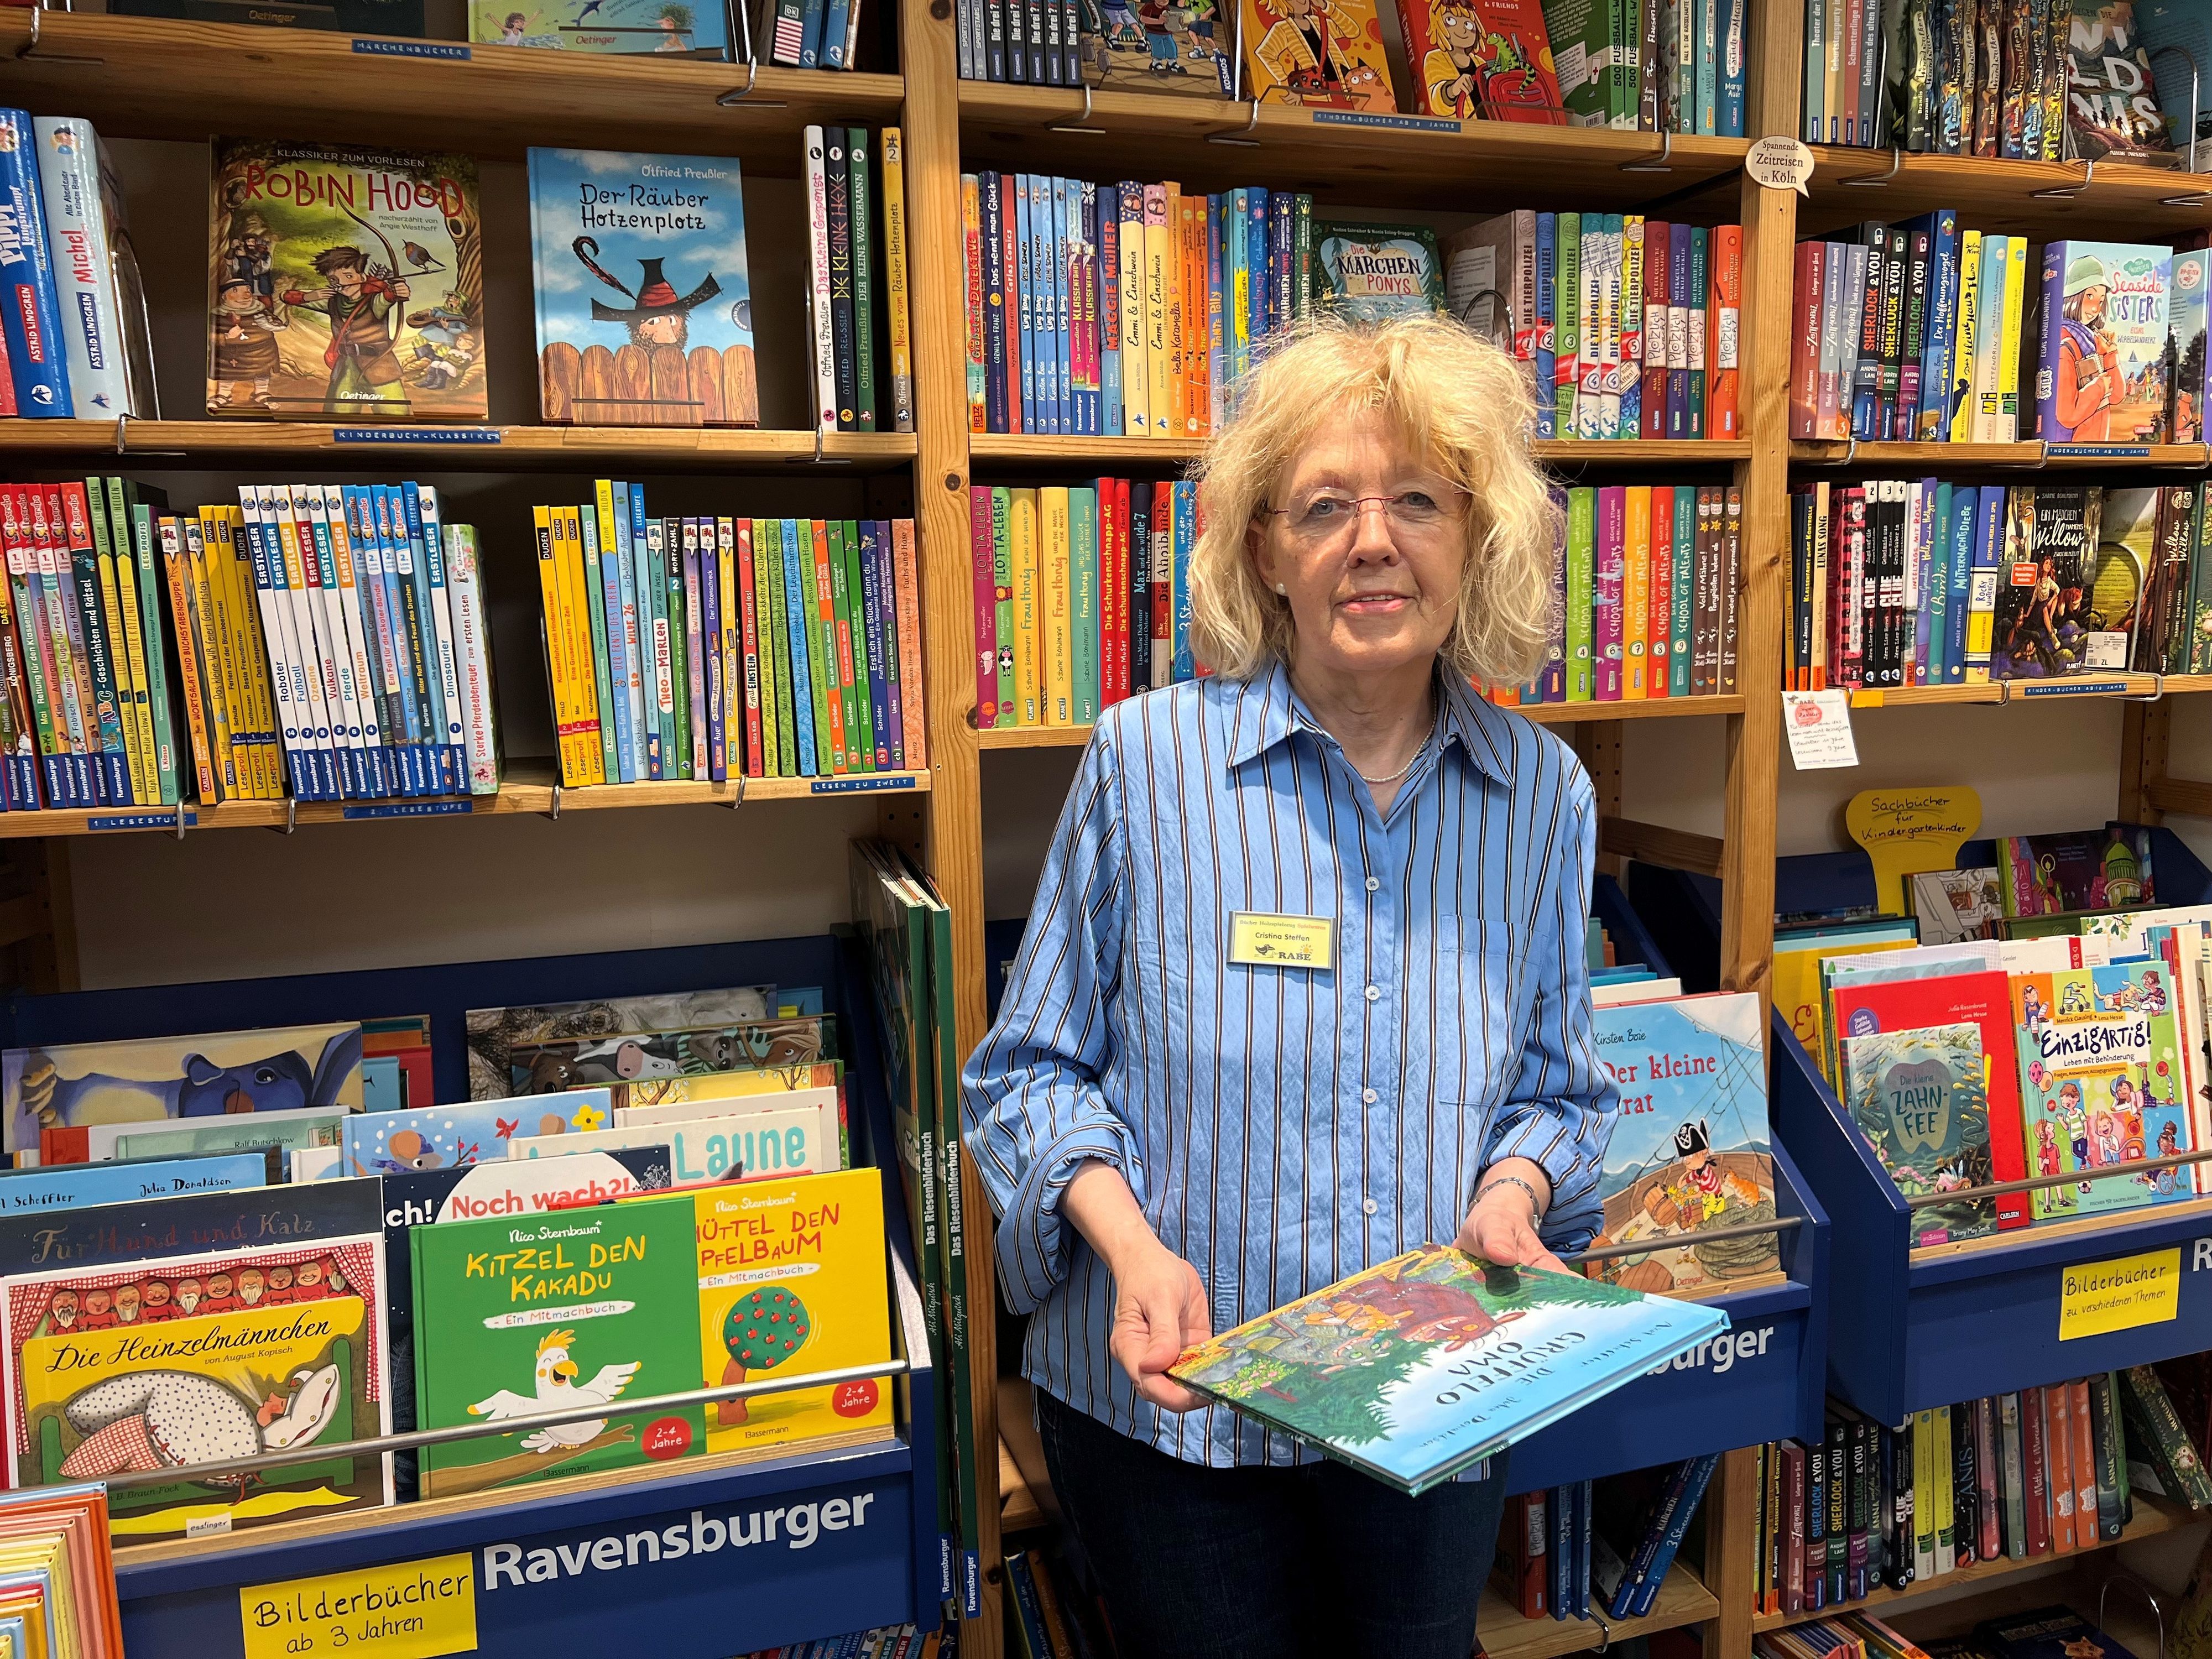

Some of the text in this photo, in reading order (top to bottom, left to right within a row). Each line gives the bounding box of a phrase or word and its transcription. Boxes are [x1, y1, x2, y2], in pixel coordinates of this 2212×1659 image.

[249, 10, 295, 23] Oetinger
[1223, 57, 1232, 91] KOSMOS
[277, 149, 425, 168] KLASSIKER ZUM VORLESEN
[1763, 140, 1799, 151] Spannende
[641, 164, 728, 180] Otfried Preußler
[1756, 153, 1803, 168] Zeitreisen
[1761, 170, 1797, 184] in Köln
[246, 166, 463, 218] ROBIN HOOD
[580, 182, 708, 207] Der Räuber
[988, 182, 998, 211] Glück
[379, 215, 422, 223] nacherzählt
[582, 205, 706, 234] Hotzenplotz
[855, 173, 865, 243] WASSERMANN
[379, 222, 438, 232] Angie Westhoff
[890, 203, 902, 255] Hotzenplotz
[60, 230, 97, 284] Michel
[858, 245, 867, 277] KLEINE
[989, 235, 999, 265] nennt
[1350, 244, 1365, 254] Die
[891, 258, 903, 292] Räuber
[991, 268, 999, 285] Das
[1336, 255, 1422, 275] MÄRCHEN
[859, 281, 867, 301] DER
[1367, 274, 1411, 295] PONYS
[1524, 245, 1532, 325] DIE TIERPOLIZEI
[2111, 270, 2164, 294] Seaside
[1125, 251, 1139, 347] Emmi & Einschwein
[1864, 252, 1881, 351] SHERLOCK & YOU
[894, 319, 906, 347] Neues
[2027, 508, 2085, 551] Willow
[2041, 509, 2077, 521] EIN MÄDCHEN
[993, 496, 1004, 575] LOTTA-LEBEN
[1817, 515, 1828, 568] LUNAS SONG
[249, 527, 268, 585] ERSTLESER
[1103, 504, 1113, 613] Schurkenschnapp-AG
[1157, 501, 1169, 603] Die Ahoibande
[864, 564, 871, 575] du
[1698, 551, 1708, 609] Volle Mähne!
[1678, 543, 1691, 633] SCHOOL OF TALENTS
[461, 594, 471, 613] Lesen
[867, 599, 875, 625] Stück,
[464, 614, 473, 644] ersten
[276, 661, 290, 702] Roboter
[324, 659, 337, 700] Vulkane
[356, 651, 370, 700] Weltraum
[440, 639, 456, 698] Dinosaurier
[747, 655, 757, 689] EINSTEIN
[291, 665, 306, 703] Fußball
[307, 665, 320, 702] Ozeane
[340, 667, 354, 701] Pferde
[468, 663, 487, 729] Pferdeabenteuer
[476, 730, 487, 758] Starke
[815, 782, 847, 790] LESEN
[1871, 795, 1951, 812] Sachbücher
[1895, 812, 1914, 824] für
[1862, 822, 1966, 840] Kindergartenkinder
[1279, 951, 1311, 961] RABE
[1593, 1029, 1646, 1046] Kirsten Boie
[1648, 1053, 1717, 1079] kleine
[2064, 1058, 2082, 1067] Leben
[2096, 1053, 2135, 1063] Behinderung
[1900, 1074, 1934, 1086] Die kleine
[1891, 1085, 1948, 1116] ZAHN-
[1903, 1112, 1938, 1138] FEE
[234, 1137, 295, 1148] Ralf Butschkow
[674, 1125, 806, 1180] Laune
[14, 1192, 75, 1208] Scheffler
[140, 1182, 166, 1197] Julia
[171, 1177, 231, 1192] Donaldson
[452, 1178, 631, 1219] Noch wach?!
[920, 1131, 936, 1245] Das Riesenbilderbuch
[791, 1203, 839, 1233] DEN
[2000, 1211, 2020, 1219] CARLSEN
[509, 1223, 601, 1243] Nico Sternbaum
[589, 1235, 646, 1268] DEN
[511, 1271, 611, 1302] KAKADU
[2065, 1264, 2167, 1296] Bilderbücher
[506, 1303, 615, 1325] Ein Mitmachbuch
[2067, 1289, 2166, 1317] zu verschiedenen Themen
[45, 1310, 332, 1373] Die Heinzelmännchen
[205, 1345, 293, 1365] von August Kopisch
[1448, 1341, 1524, 1376] OMA
[651, 1436, 683, 1449] Jahre
[656, 1427, 677, 1438] 2-4
[745, 1425, 789, 1439] Bassermann
[543, 1464, 590, 1478] Bassermann
[1833, 1449, 1843, 1469] YOU
[1832, 1480, 1843, 1531] SHERLOCK
[190, 1521, 228, 1531] esslinger
[484, 1493, 874, 1590] Ravensburger
[967, 1556, 977, 1611] Ravensburger
[253, 1572, 469, 1629] Bilderbücher
[286, 1613, 424, 1655] ab 3 Jahren
